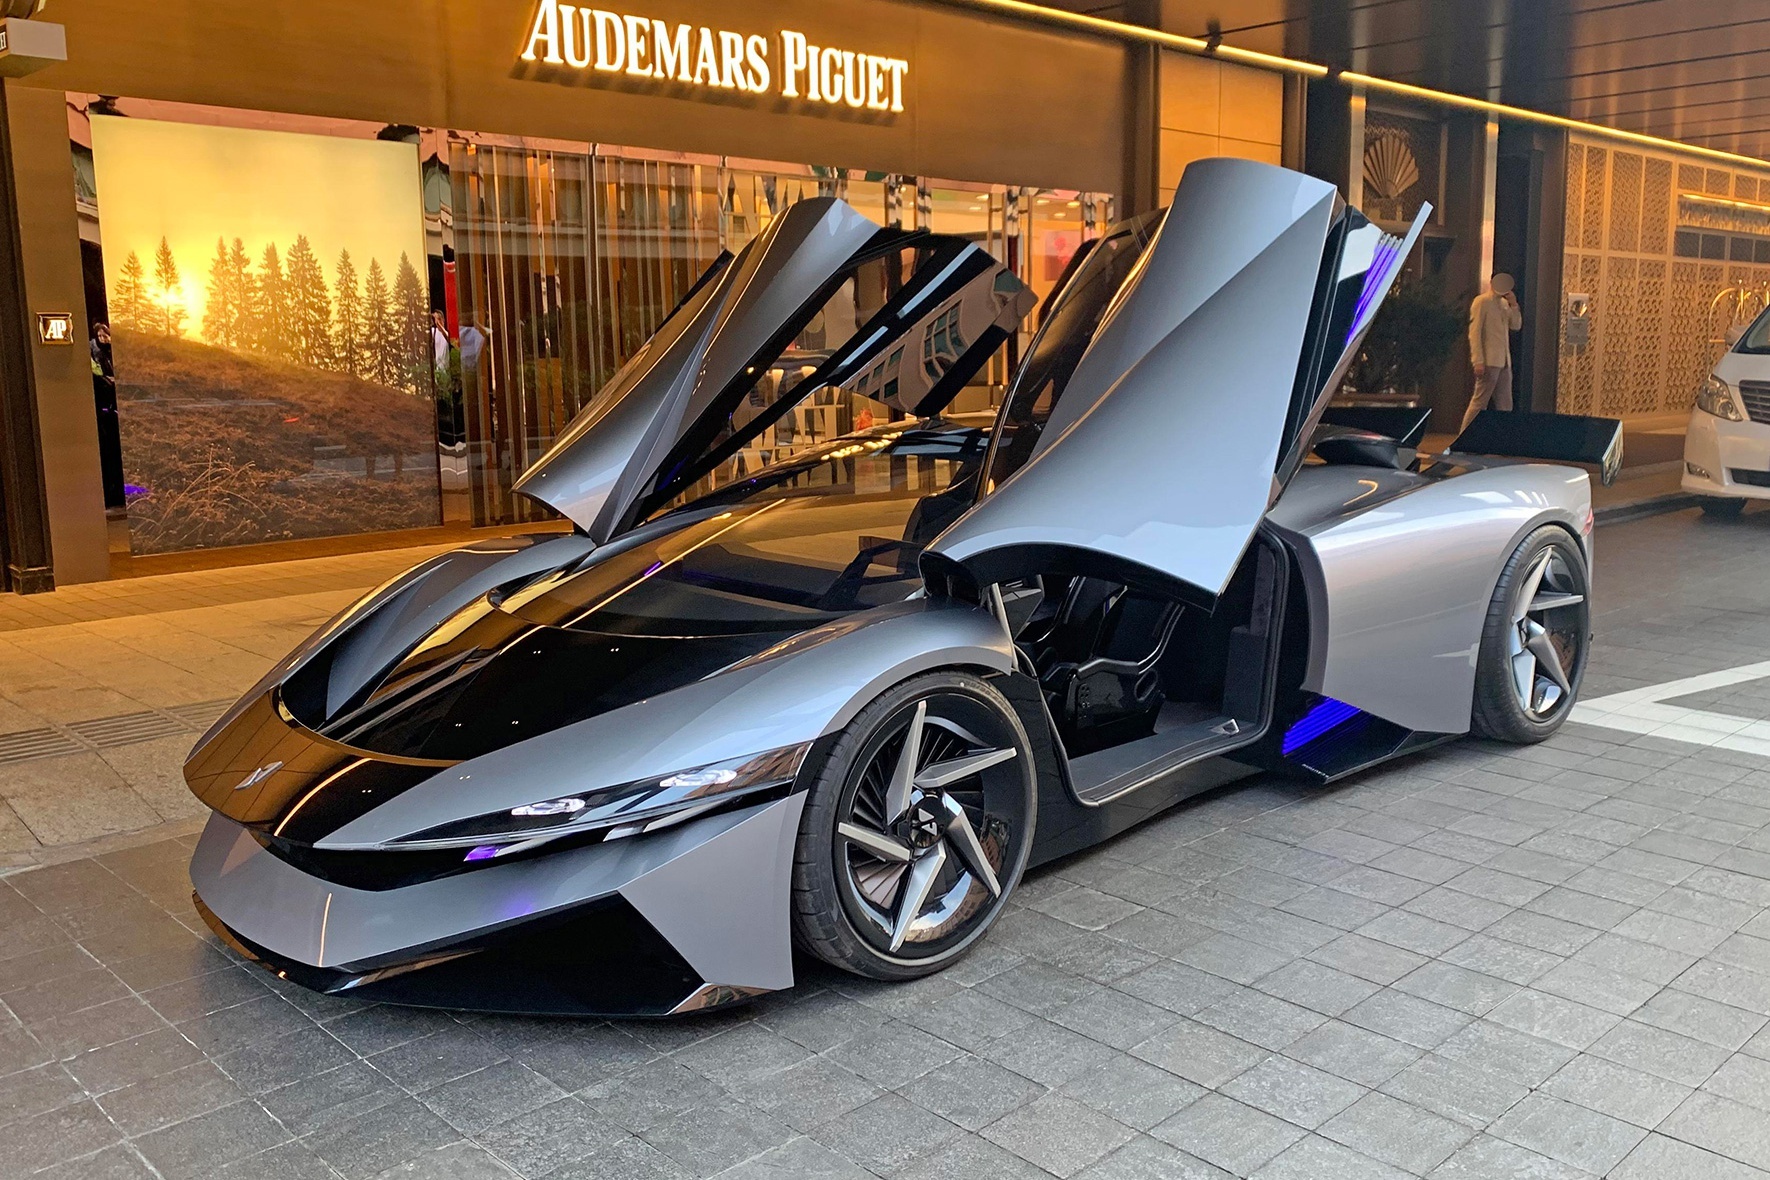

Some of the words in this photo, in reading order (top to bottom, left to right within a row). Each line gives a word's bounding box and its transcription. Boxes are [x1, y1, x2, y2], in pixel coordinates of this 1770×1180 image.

[521, 0, 770, 94] AUDEMARS
[780, 29, 909, 112] PIGUET
[45, 319, 67, 340] AP
